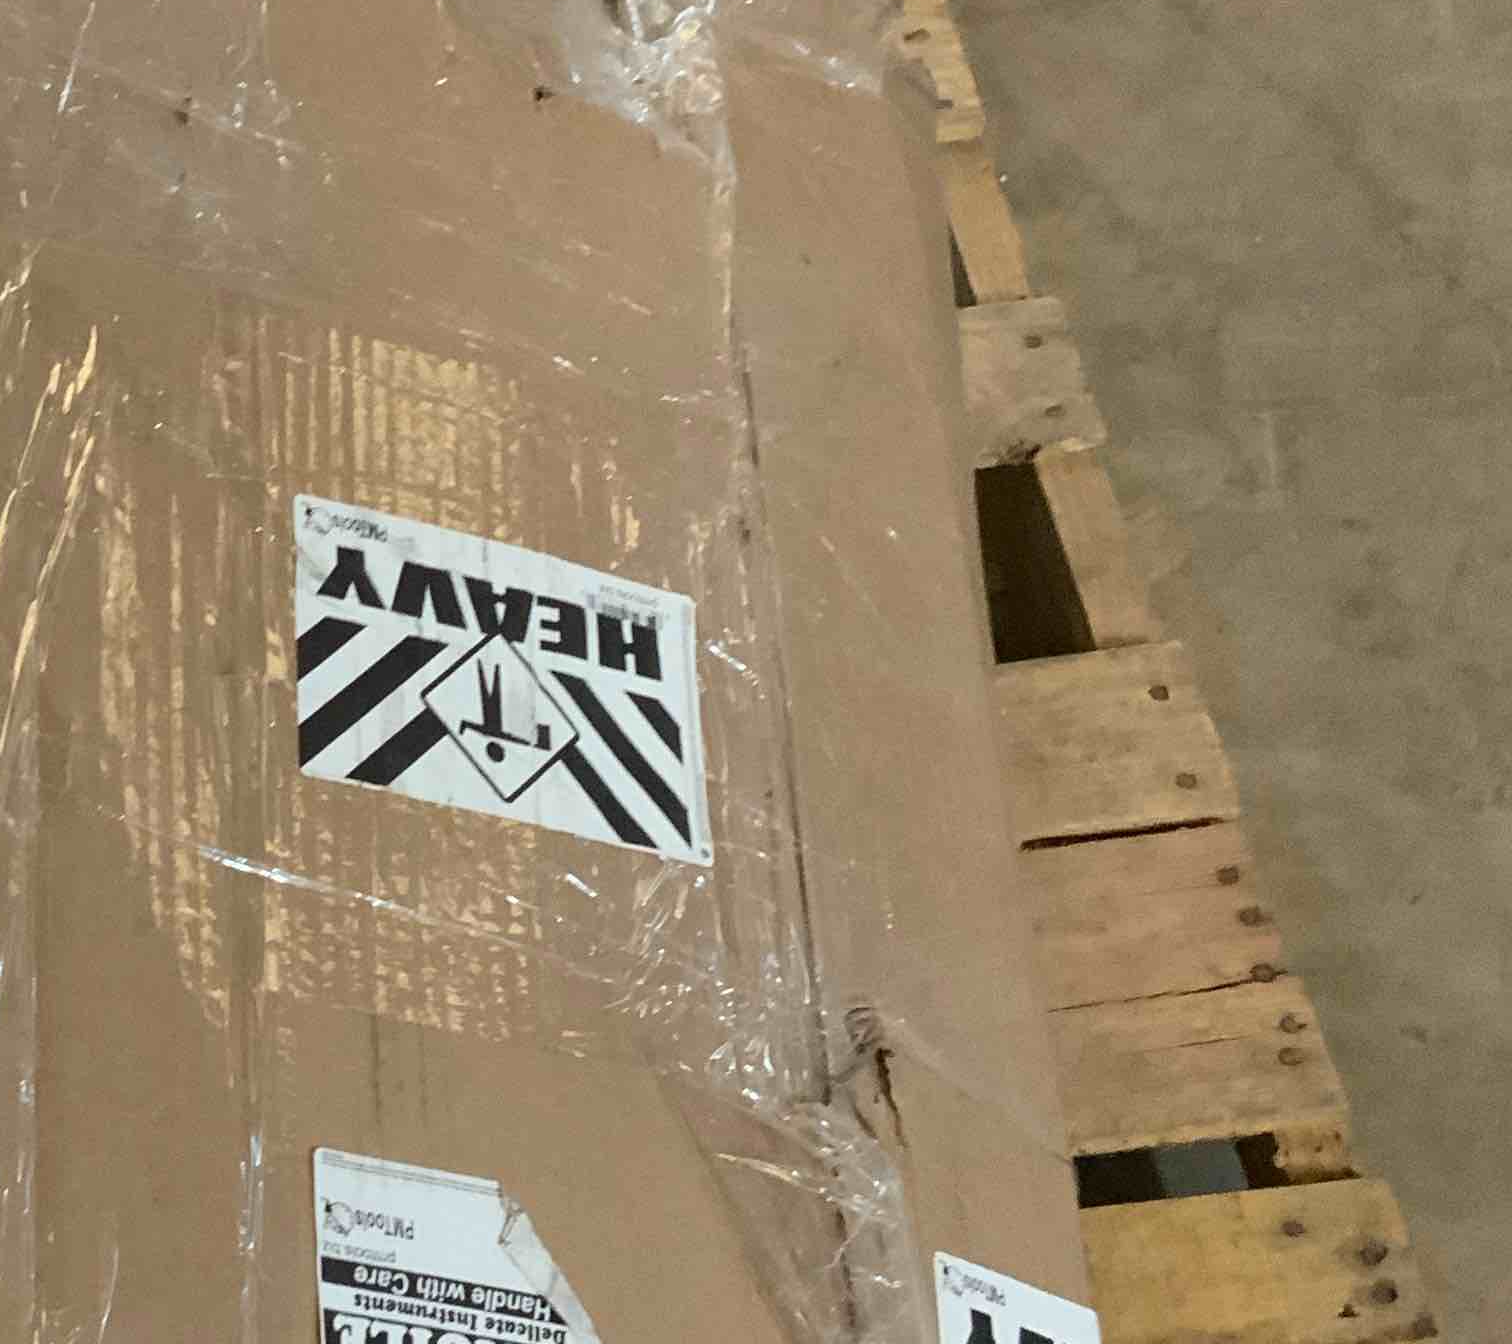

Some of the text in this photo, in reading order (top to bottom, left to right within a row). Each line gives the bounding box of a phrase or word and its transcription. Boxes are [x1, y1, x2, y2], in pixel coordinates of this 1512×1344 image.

[316, 546, 662, 682] HEAVY
[353, 1265, 553, 1321] Handle with Care
[353, 1292, 478, 1333] Instruments
